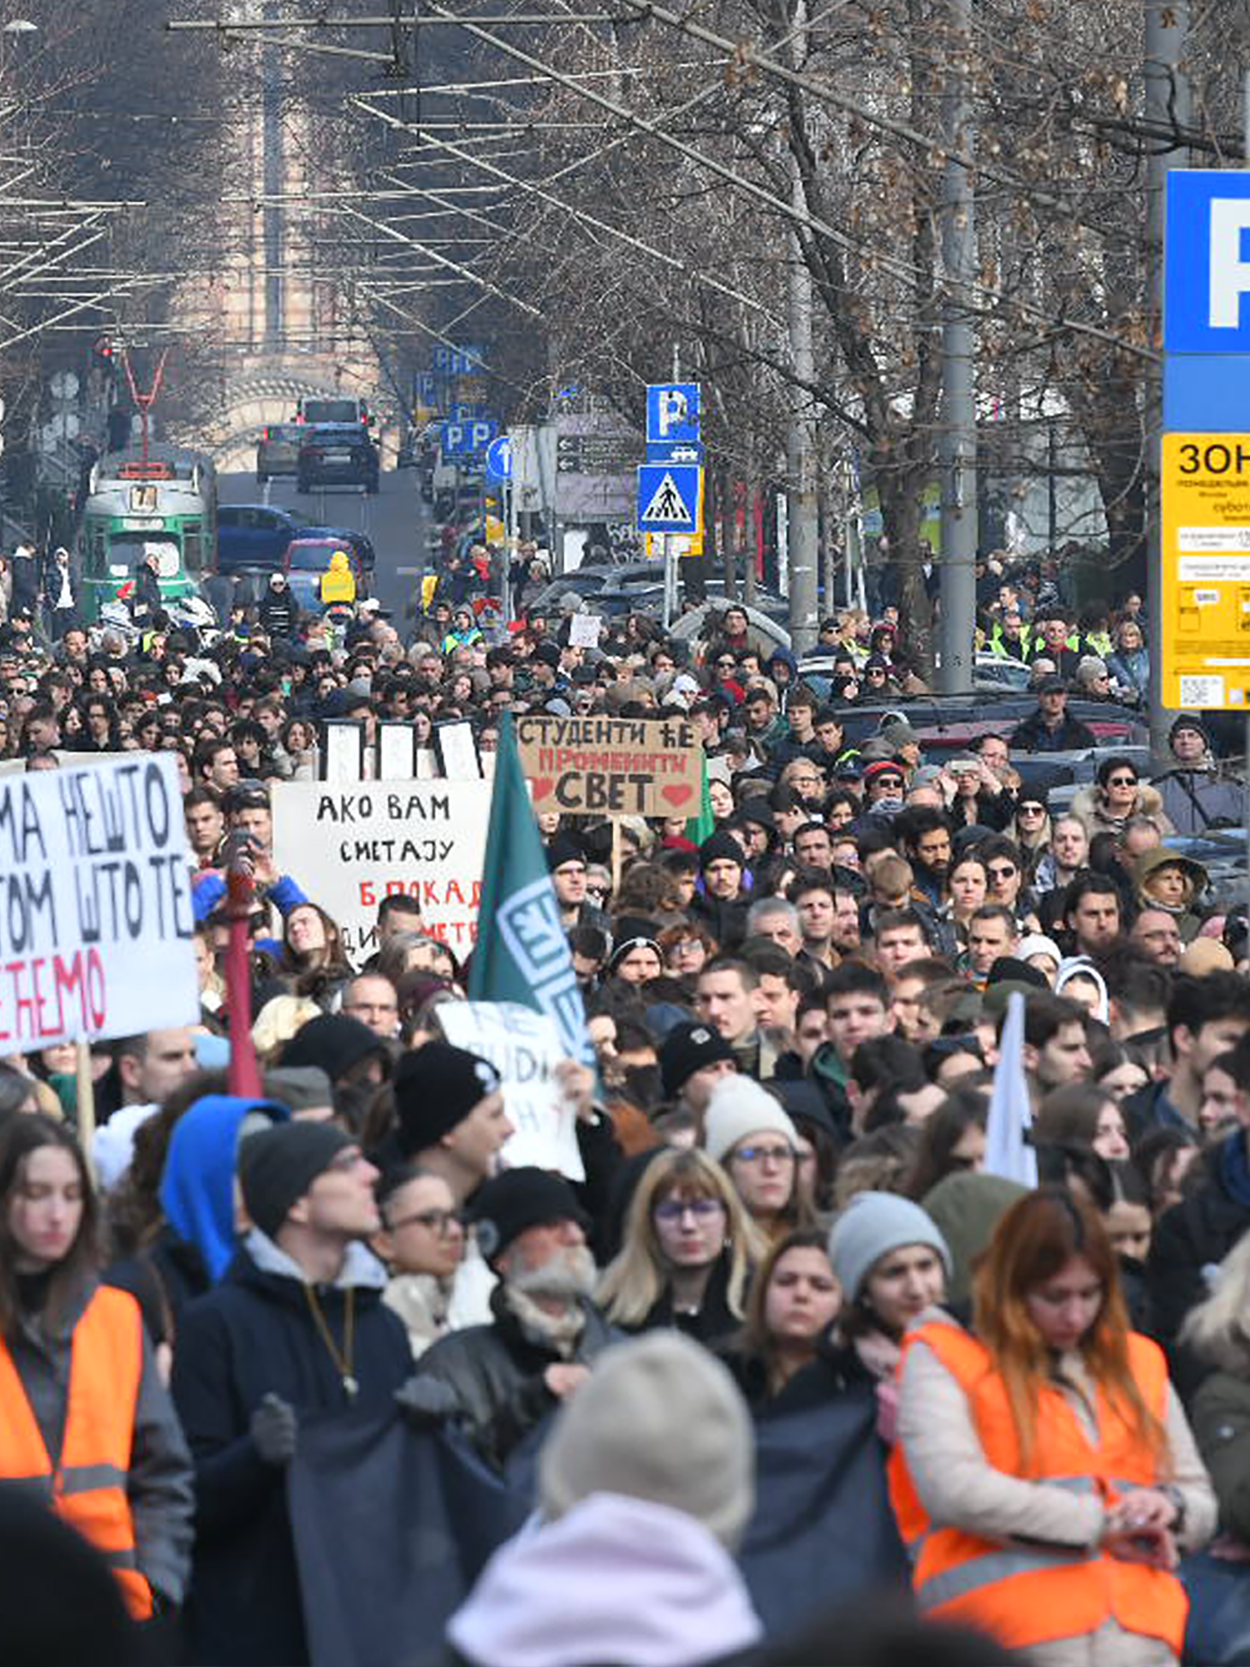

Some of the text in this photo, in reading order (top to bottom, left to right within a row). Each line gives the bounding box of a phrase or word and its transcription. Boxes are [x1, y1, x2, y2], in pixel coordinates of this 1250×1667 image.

[659, 390, 688, 436] P
[447, 425, 463, 451] P
[473, 422, 489, 448] P
[518, 720, 646, 748] СТУДЕНТИ
[554, 771, 654, 812] СВЕТ
[58, 762, 170, 858] НЕШТО
[317, 794, 451, 824] АКО ВАМ
[340, 840, 455, 863] СМЕТАЈУ
